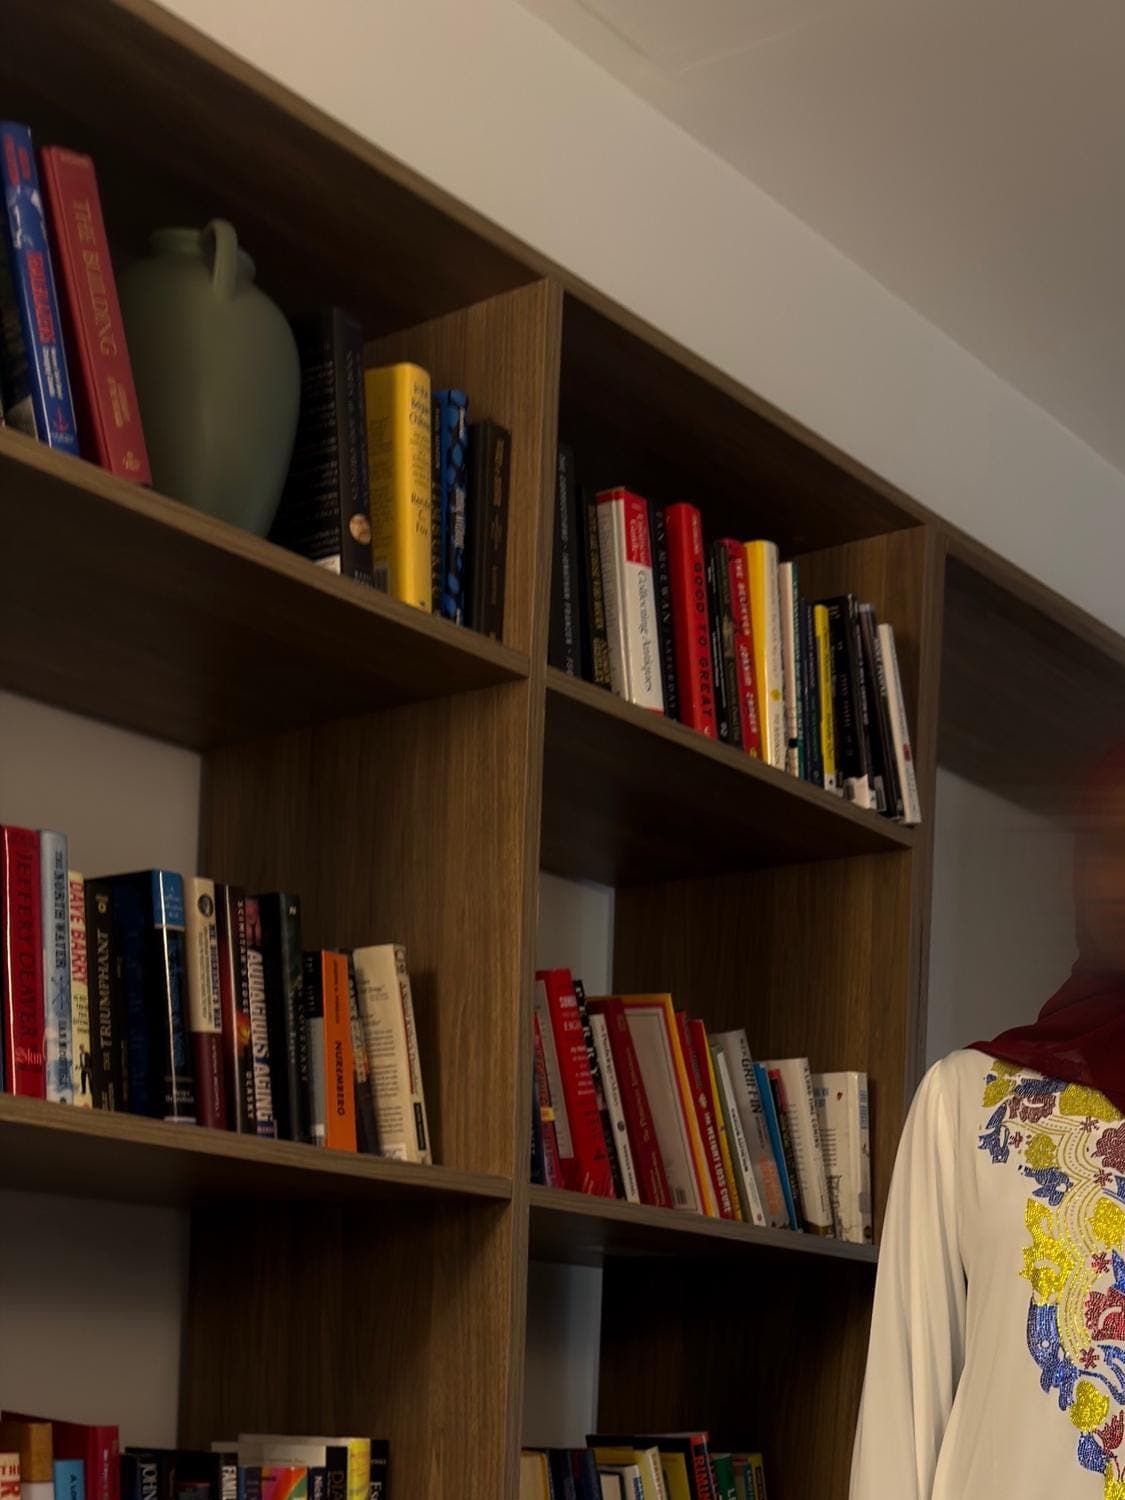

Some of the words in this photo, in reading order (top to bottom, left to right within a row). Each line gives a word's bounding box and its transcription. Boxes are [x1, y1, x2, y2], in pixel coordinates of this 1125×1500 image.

[74, 200, 96, 246] THE
[694, 563, 705, 613] GOOD
[735, 558, 744, 578] THE
[698, 626, 707, 647] TO
[700, 659, 713, 718] GREAT
[55, 871, 66, 920] NORTH
[70, 881, 84, 926] DAVE
[55, 923, 66, 969] WATER
[71, 928, 87, 983] BARRY
[97, 928, 112, 1049] TRIUMPHANT
[248, 950, 269, 1058] AUDACIOUS
[17, 1046, 43, 1067] Skin
[334, 1040, 346, 1117] NUREMBERG
[254, 1062, 272, 1122] AGING
[741, 1058, 762, 1113] GRIFFIN
[706, 1125, 720, 1162] WEIGHT
[714, 1160, 725, 1188] LOSS
[719, 1187, 732, 1213] CURE
[70, 1474, 77, 1483] A
